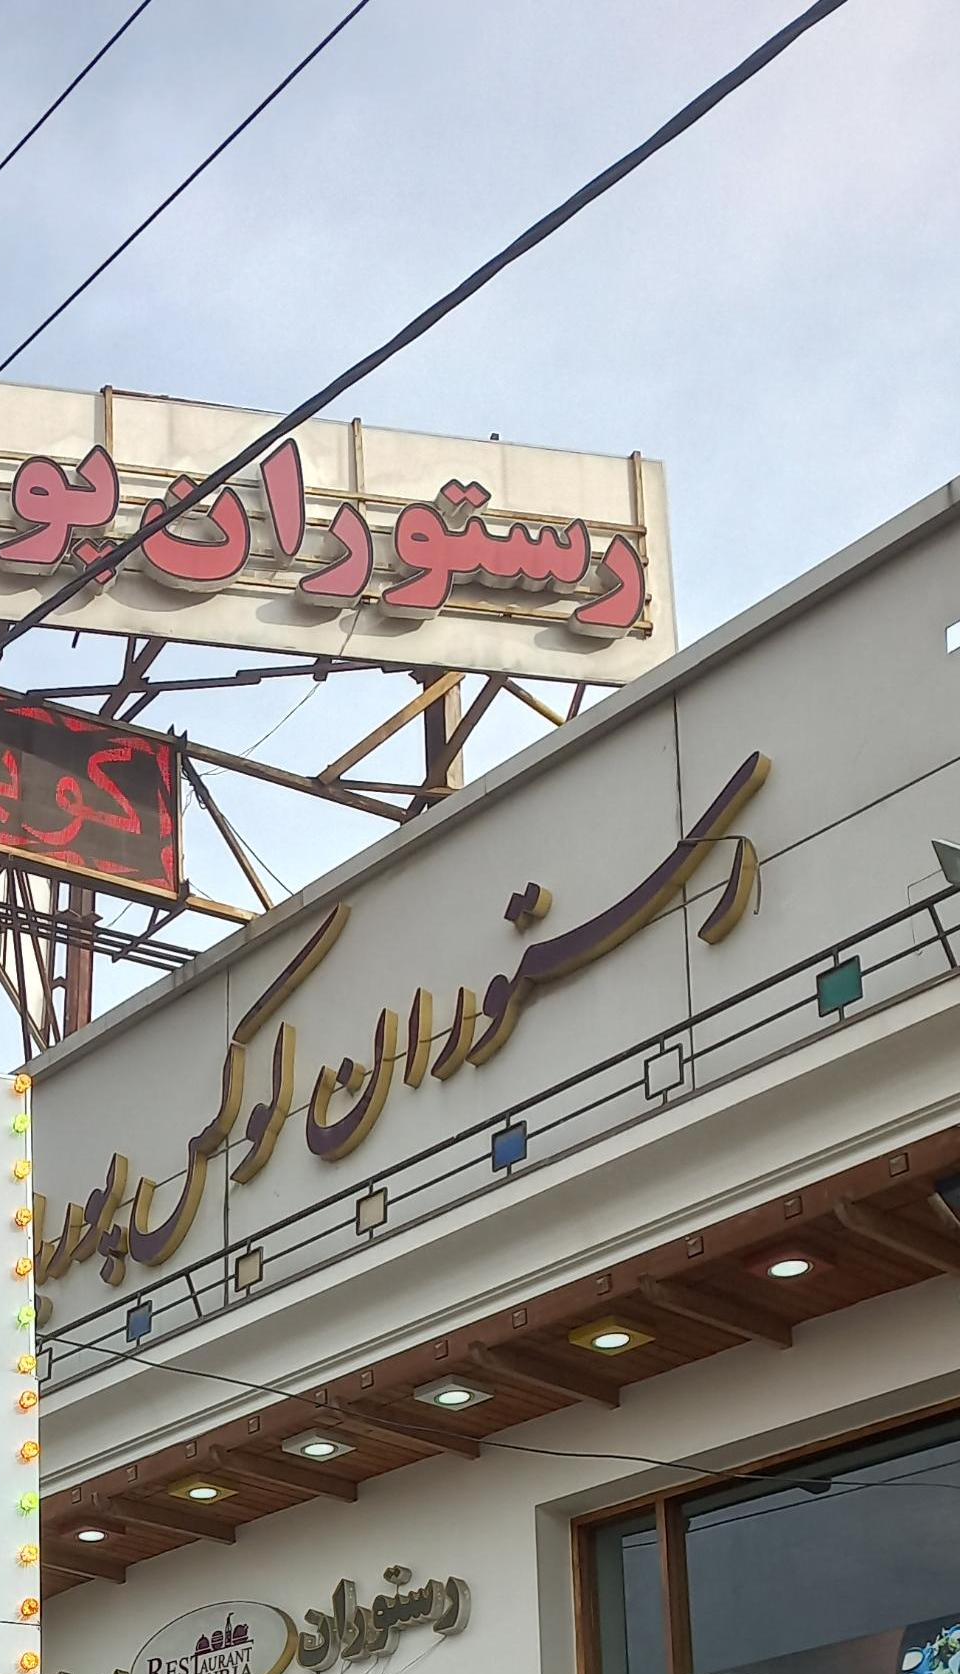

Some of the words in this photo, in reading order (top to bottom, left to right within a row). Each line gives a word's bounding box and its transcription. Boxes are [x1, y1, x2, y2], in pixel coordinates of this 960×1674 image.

[138, 436, 646, 637] رستوران
[305, 751, 771, 1162] رستوران
[296, 1565, 471, 1672] رستوران
